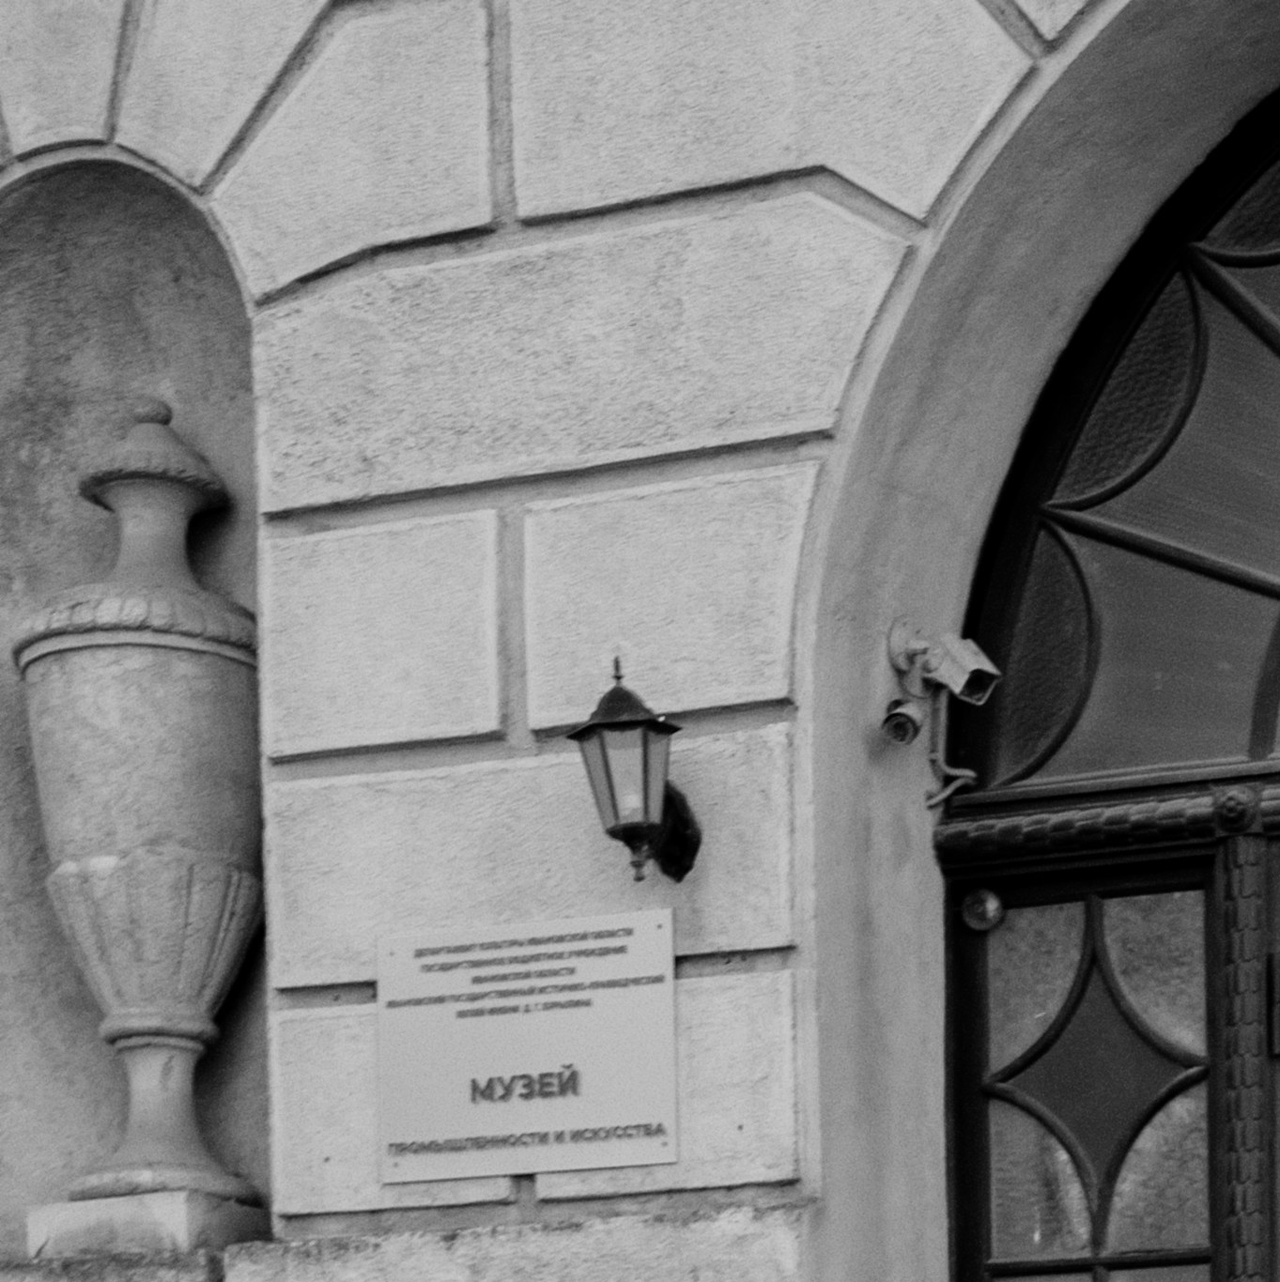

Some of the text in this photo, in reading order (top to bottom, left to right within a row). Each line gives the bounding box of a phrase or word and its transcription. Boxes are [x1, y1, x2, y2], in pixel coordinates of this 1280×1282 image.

[470, 1064, 581, 1104] МУЗЕЙ
[553, 1129, 565, 1144] И
[569, 1121, 667, 1143] ИСКУССТВА
